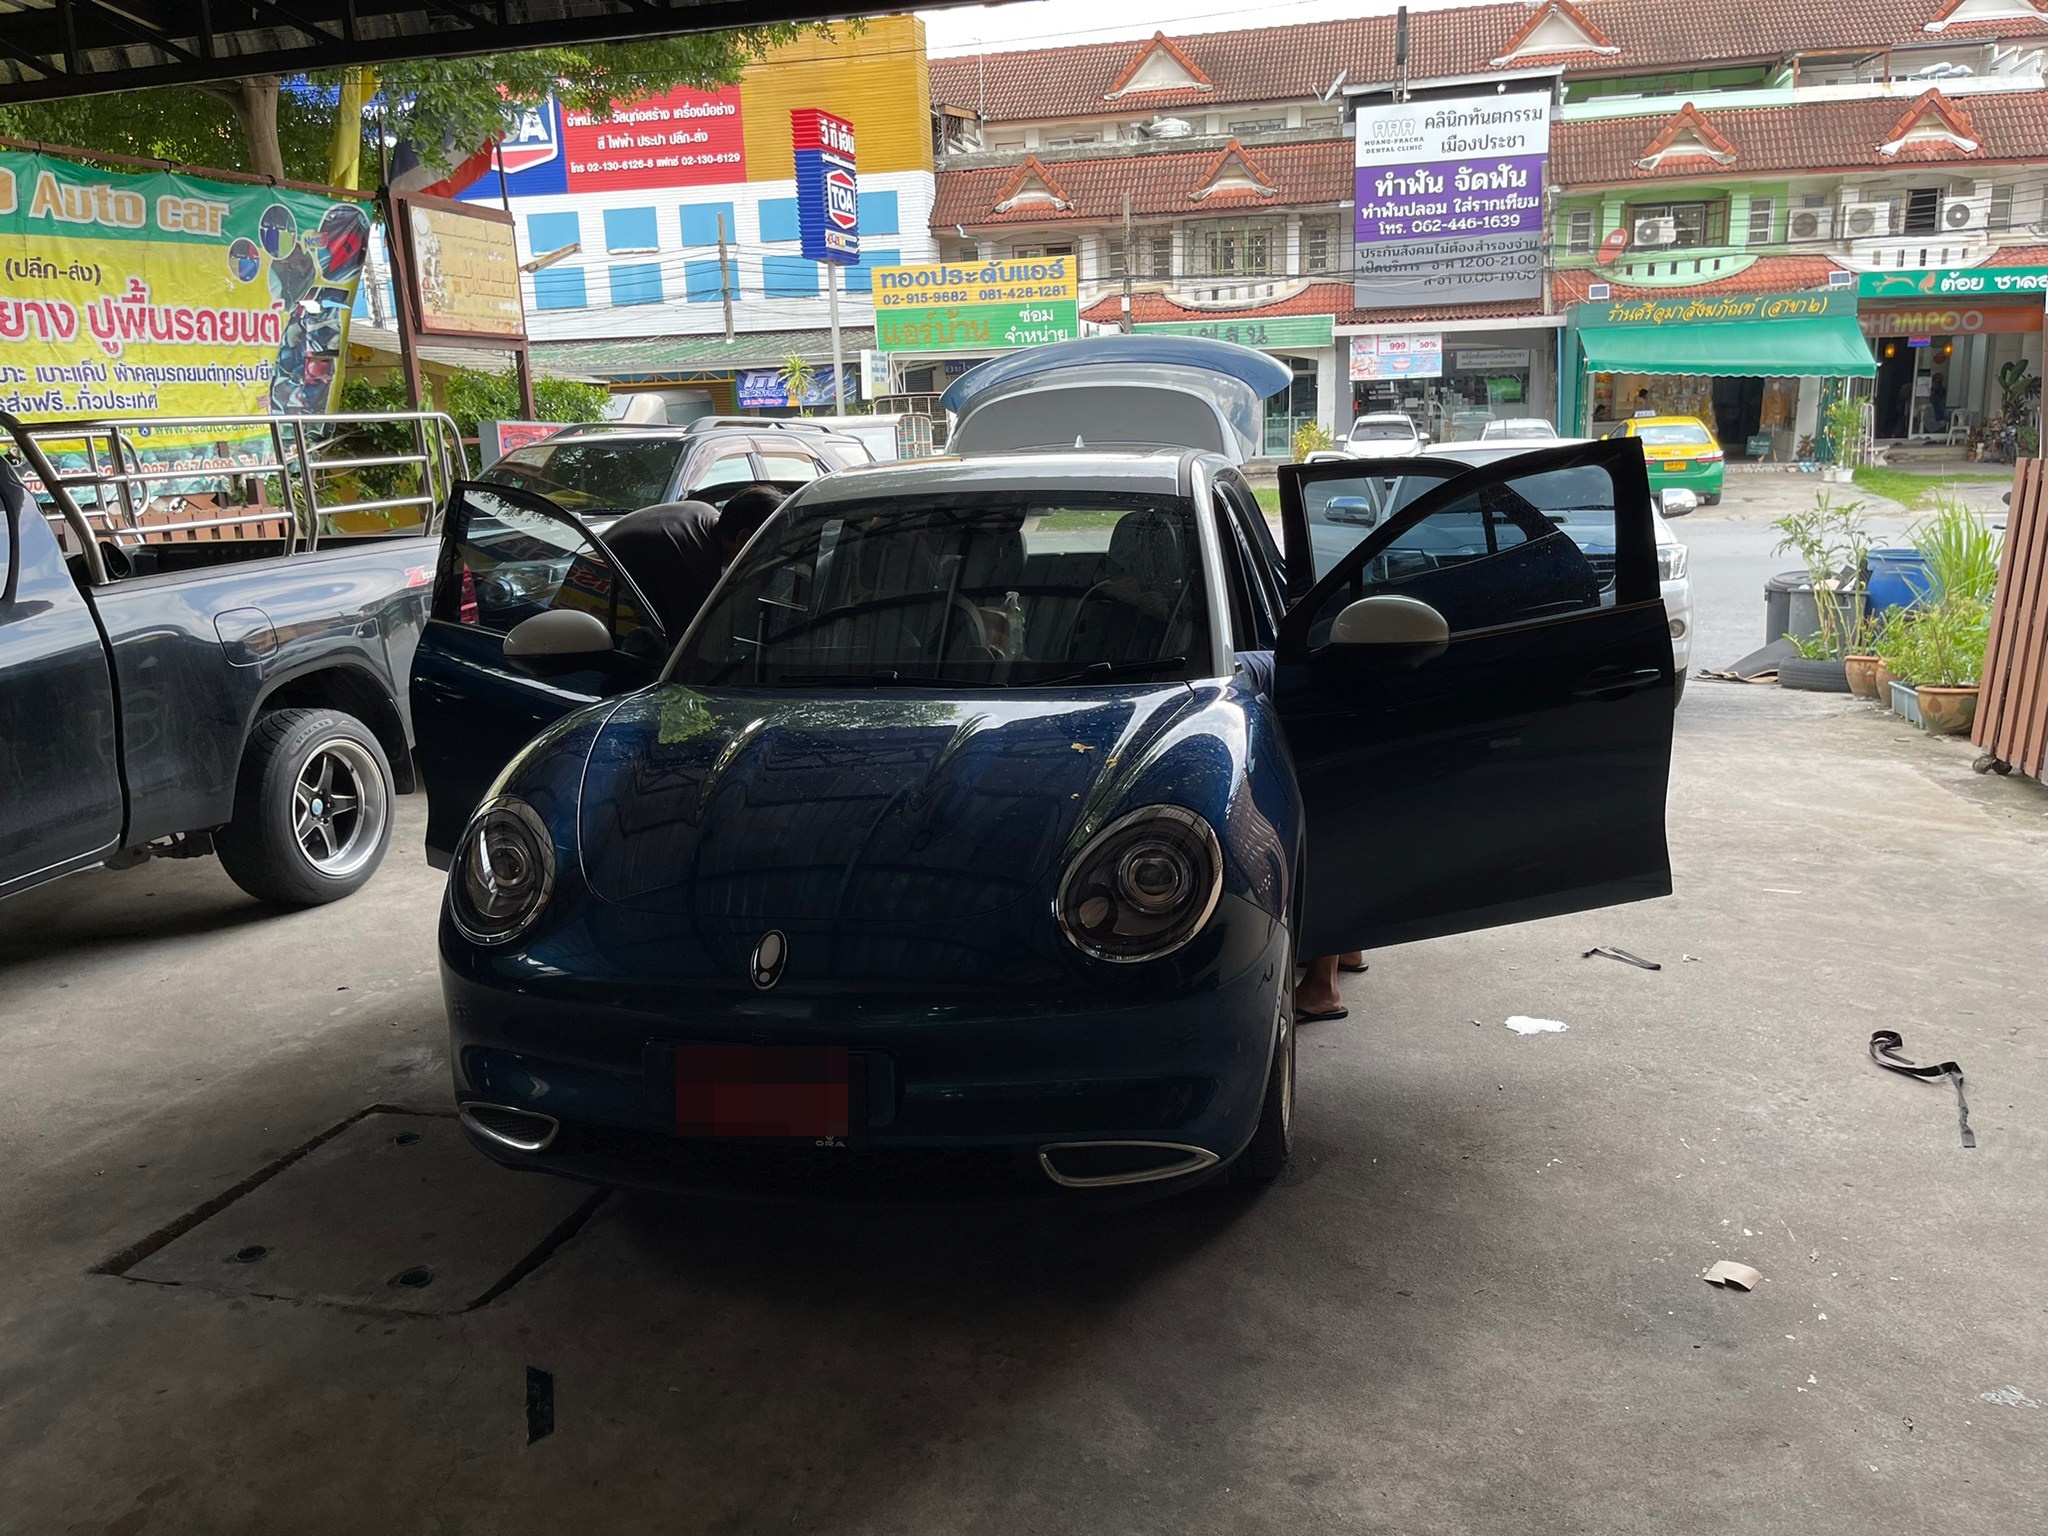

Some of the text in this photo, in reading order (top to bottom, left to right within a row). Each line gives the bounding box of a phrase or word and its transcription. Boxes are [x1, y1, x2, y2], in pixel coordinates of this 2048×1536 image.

[613, 107, 670, 127] วัสดุก่อสร้าง
[674, 101, 735, 120] เครื่องมือช่าง
[1424, 107, 1543, 129] คลินิกทันตกรรม
[637, 134, 666, 148] ประปา
[1364, 136, 1425, 147] MUANG-PRACHA
[1366, 144, 1423, 154] DENTAL CLINIC
[1441, 134, 1525, 154] เมืองประชา
[587, 159, 654, 173] 02-130-6126-8
[682, 152, 740, 166] 02-130-6129
[1375, 163, 1527, 197] ทำฟัน จัดฟัน
[29, 170, 146, 228] Auto
[157, 195, 229, 236] car
[831, 185, 854, 214] TOA
[1362, 193, 1539, 219] ทำฟันปลอม ใส่รากเทียม
[1379, 214, 1520, 235] โทร. 062-446-1639
[5, 256, 102, 286] (ปลีก-ส่ง)
[880, 257, 1065, 289] ทองประดับแอร์
[1940, 271, 1984, 292] ต้อย
[883, 284, 1067, 305] 02-915-9682 081-428-1281
[88, 279, 283, 354] ปูพื้นรถยนต์
[1019, 303, 1054, 323] ซ่อม
[1859, 310, 1983, 334] SHAMPOO
[882, 308, 990, 345] แอร์บ้าน
[1005, 325, 1069, 343] จำหน่าย
[1389, 339, 1437, 351] 999 50%
[815, 1140, 845, 1148] ORA
